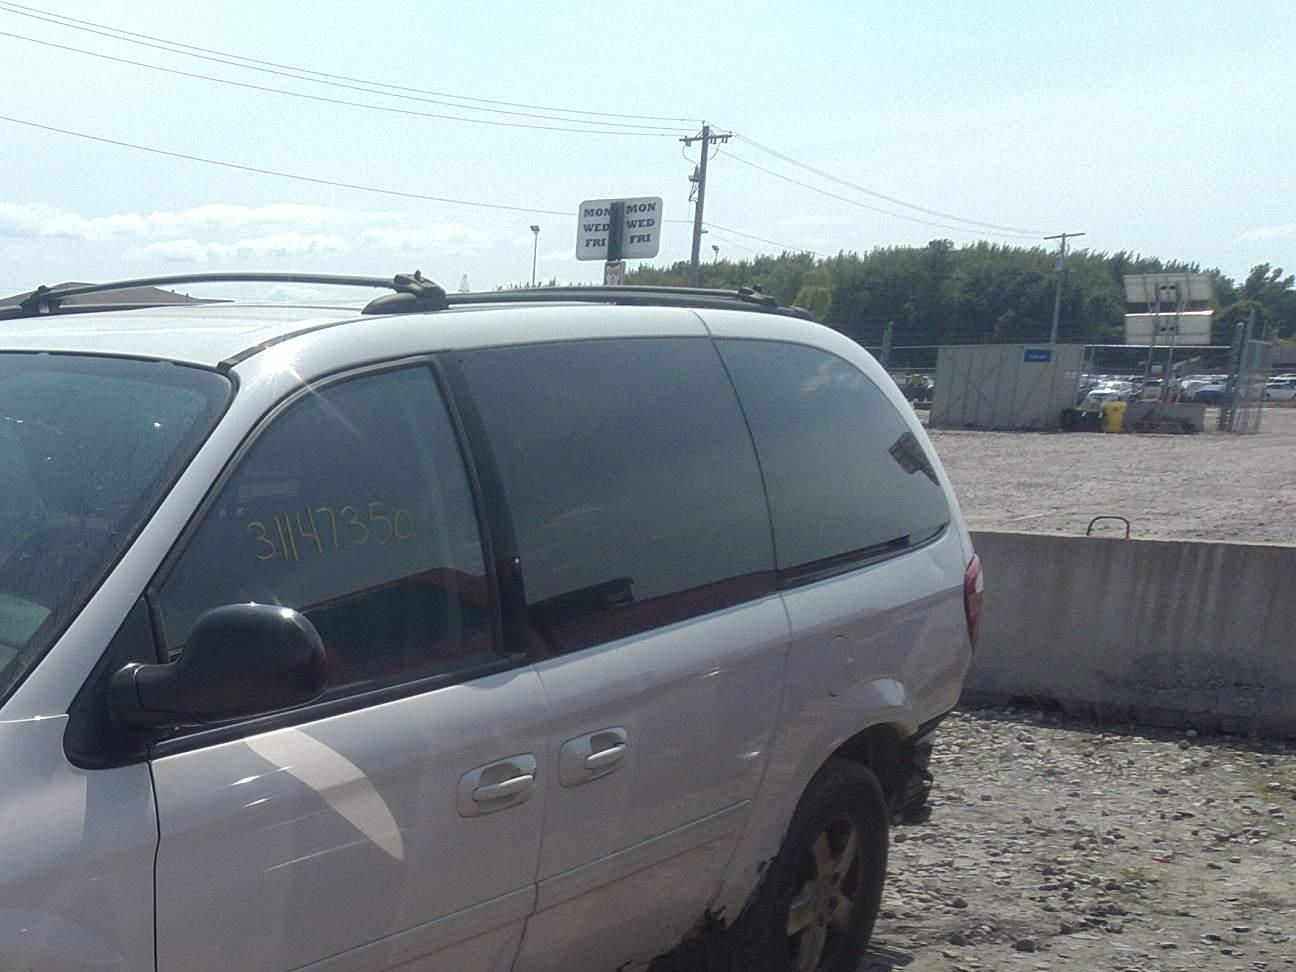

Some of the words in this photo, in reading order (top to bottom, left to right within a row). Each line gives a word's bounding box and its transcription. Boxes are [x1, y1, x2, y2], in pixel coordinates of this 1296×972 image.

[626, 202, 656, 214] MON
[626, 218, 655, 229] WED
[585, 238, 606, 247] FRI
[629, 234, 651, 244] FRI
[247, 503, 417, 561] 31147350
